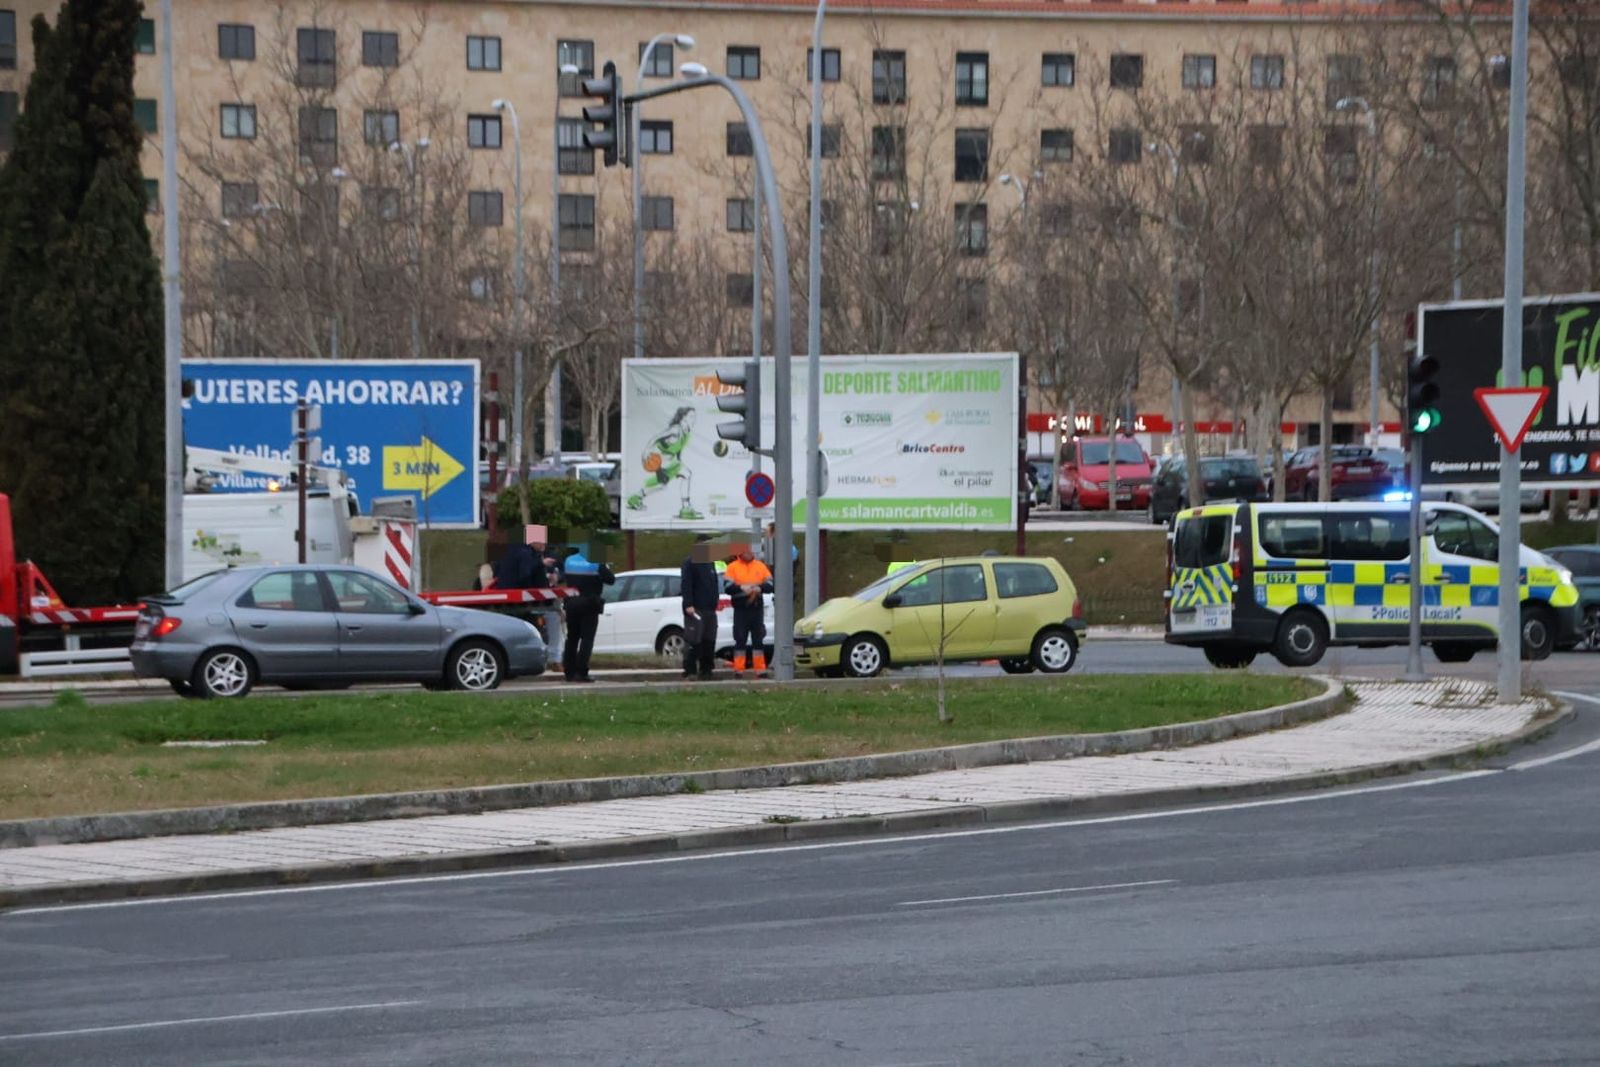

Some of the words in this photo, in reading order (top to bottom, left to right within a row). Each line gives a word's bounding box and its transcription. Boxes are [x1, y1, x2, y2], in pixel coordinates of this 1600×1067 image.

[823, 371, 892, 394] DEPORTE
[897, 370, 1001, 393] SALMANTINO
[184, 379, 298, 407] UIERES
[305, 380, 463, 405] AHORRAR?
[695, 383, 716, 396] AL
[902, 443, 965, 453] BricoCentro
[346, 446, 371, 465] 38
[393, 461, 401, 475] 3
[406, 462, 440, 475] MIN
[954, 476, 965, 485] el
[967, 476, 992, 488] pilar
[819, 503, 994, 520] ww.salamancartvaldia.es
[1380, 607, 1410, 619] Polic
[1423, 607, 1454, 619] Local
